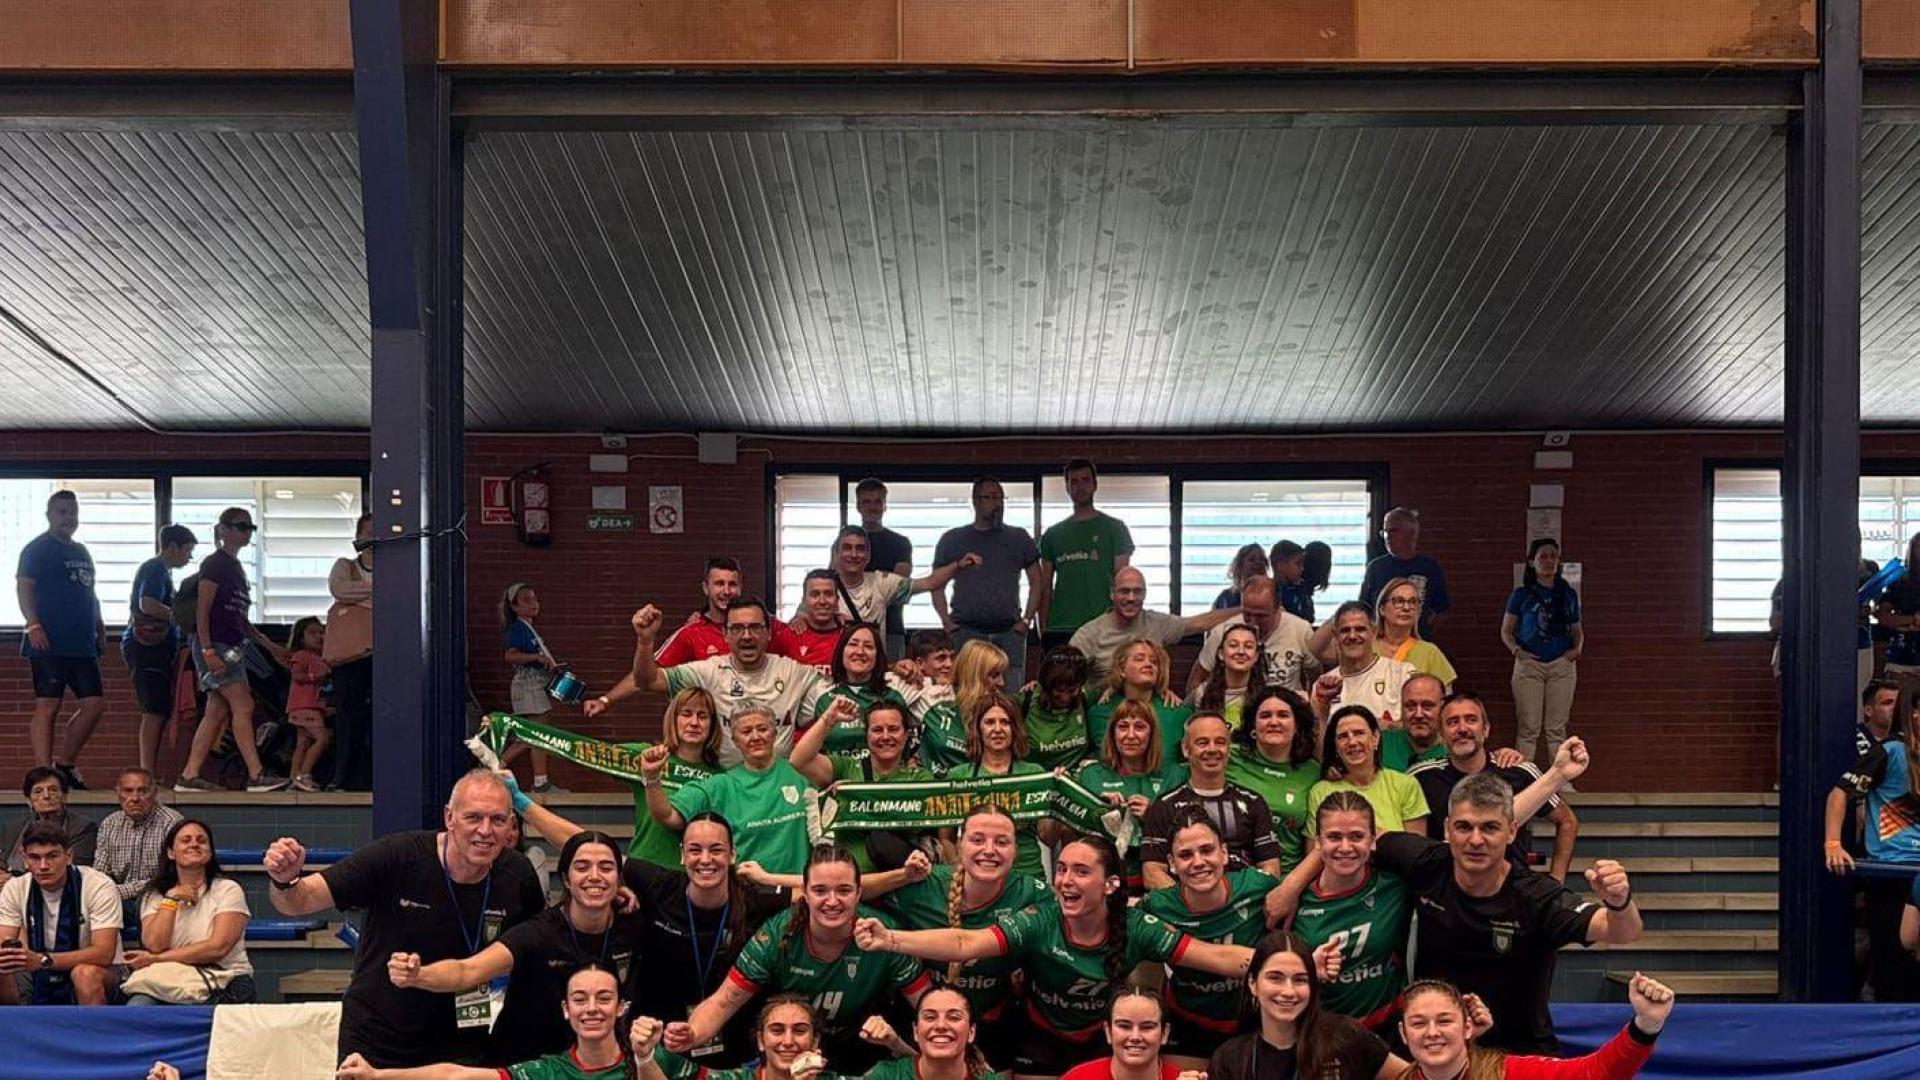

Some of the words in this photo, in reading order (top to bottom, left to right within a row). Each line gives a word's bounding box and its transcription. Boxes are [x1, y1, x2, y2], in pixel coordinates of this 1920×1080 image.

[602, 517, 623, 528] DEA
[1039, 735, 1086, 752] helvetia
[951, 778, 991, 789] helvetia
[849, 800, 922, 813] BALONMANO
